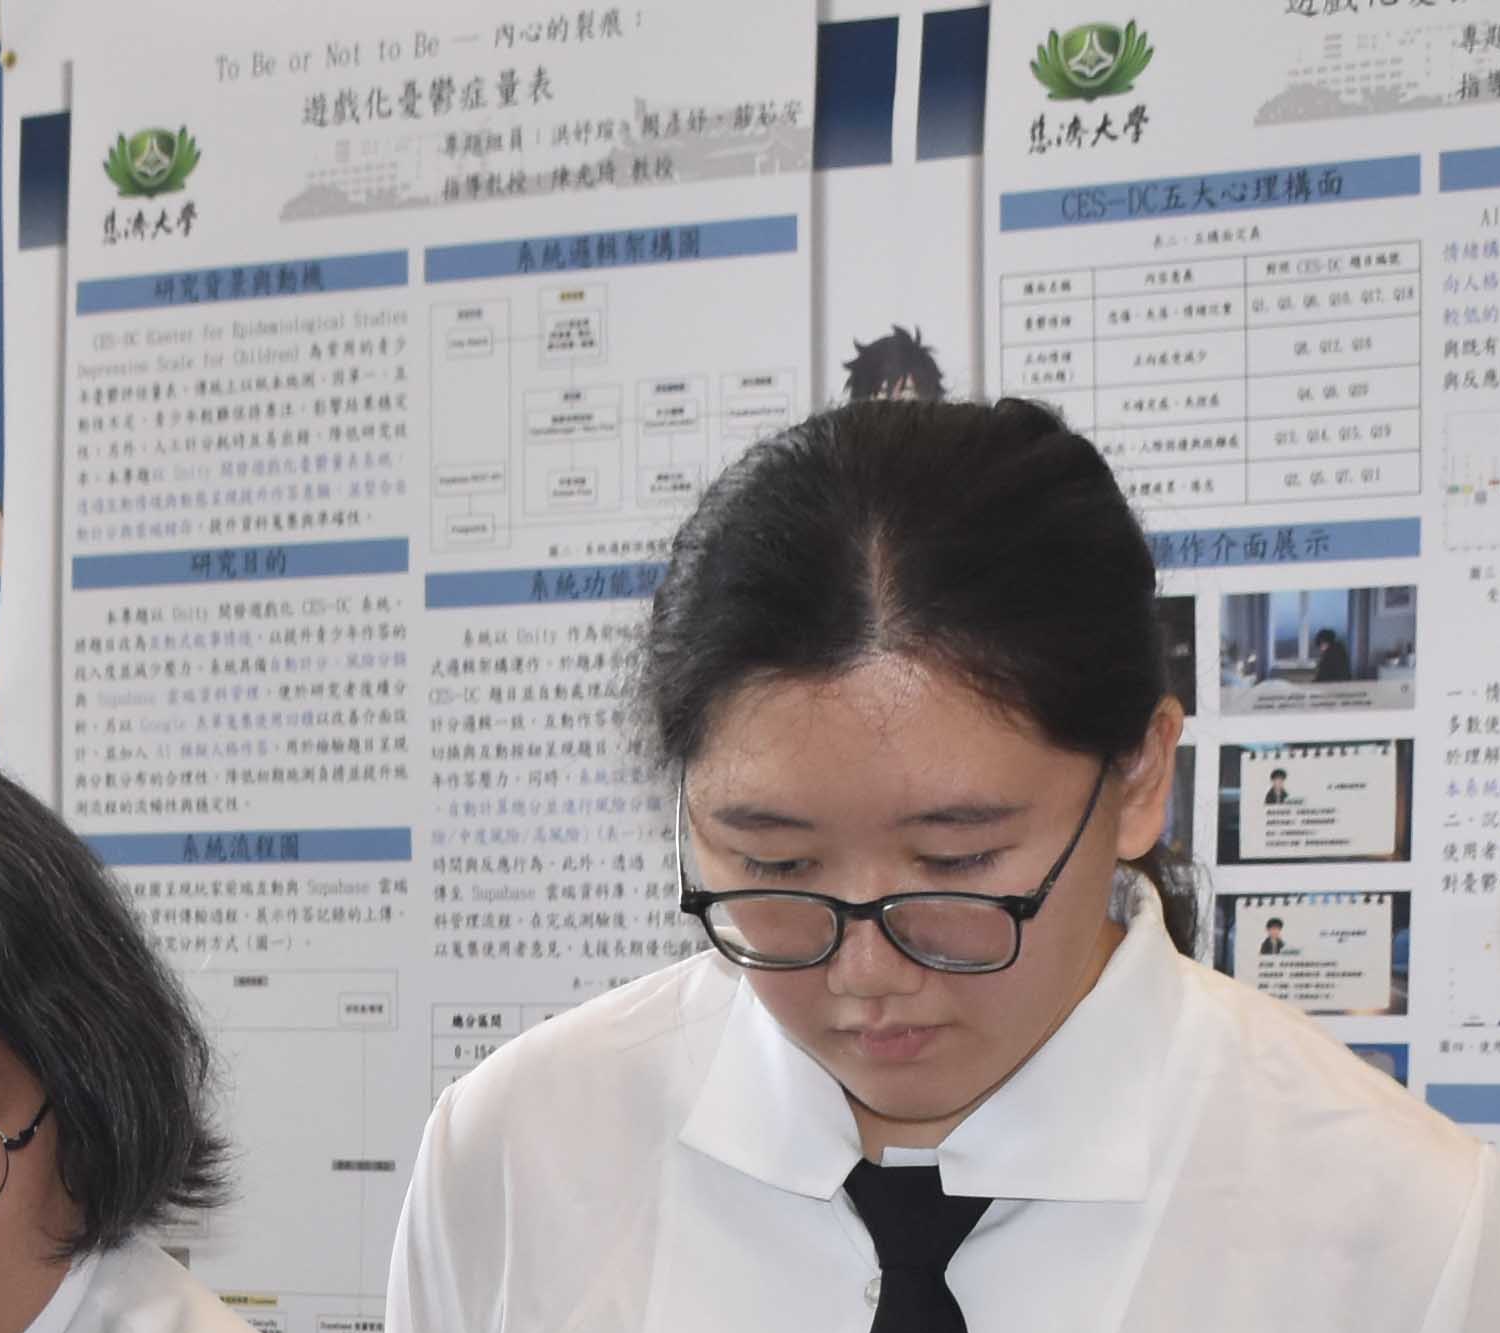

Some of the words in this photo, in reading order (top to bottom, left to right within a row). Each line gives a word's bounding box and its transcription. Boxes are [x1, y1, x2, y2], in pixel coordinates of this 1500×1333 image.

[215, 53, 240, 82] To
[251, 51, 276, 78] Be
[289, 52, 311, 72] or
[325, 42, 361, 69] Not
[378, 36, 400, 60] to
[414, 30, 440, 58] Be
[302, 64, 554, 127] 遊戲化憂鬱症量表
[1029, 105, 1149, 154] 慈濟大學
[1481, 207, 1499, 228] AI
[191, 548, 287, 580] 研究目的
[182, 832, 299, 863] 系統流程圖
